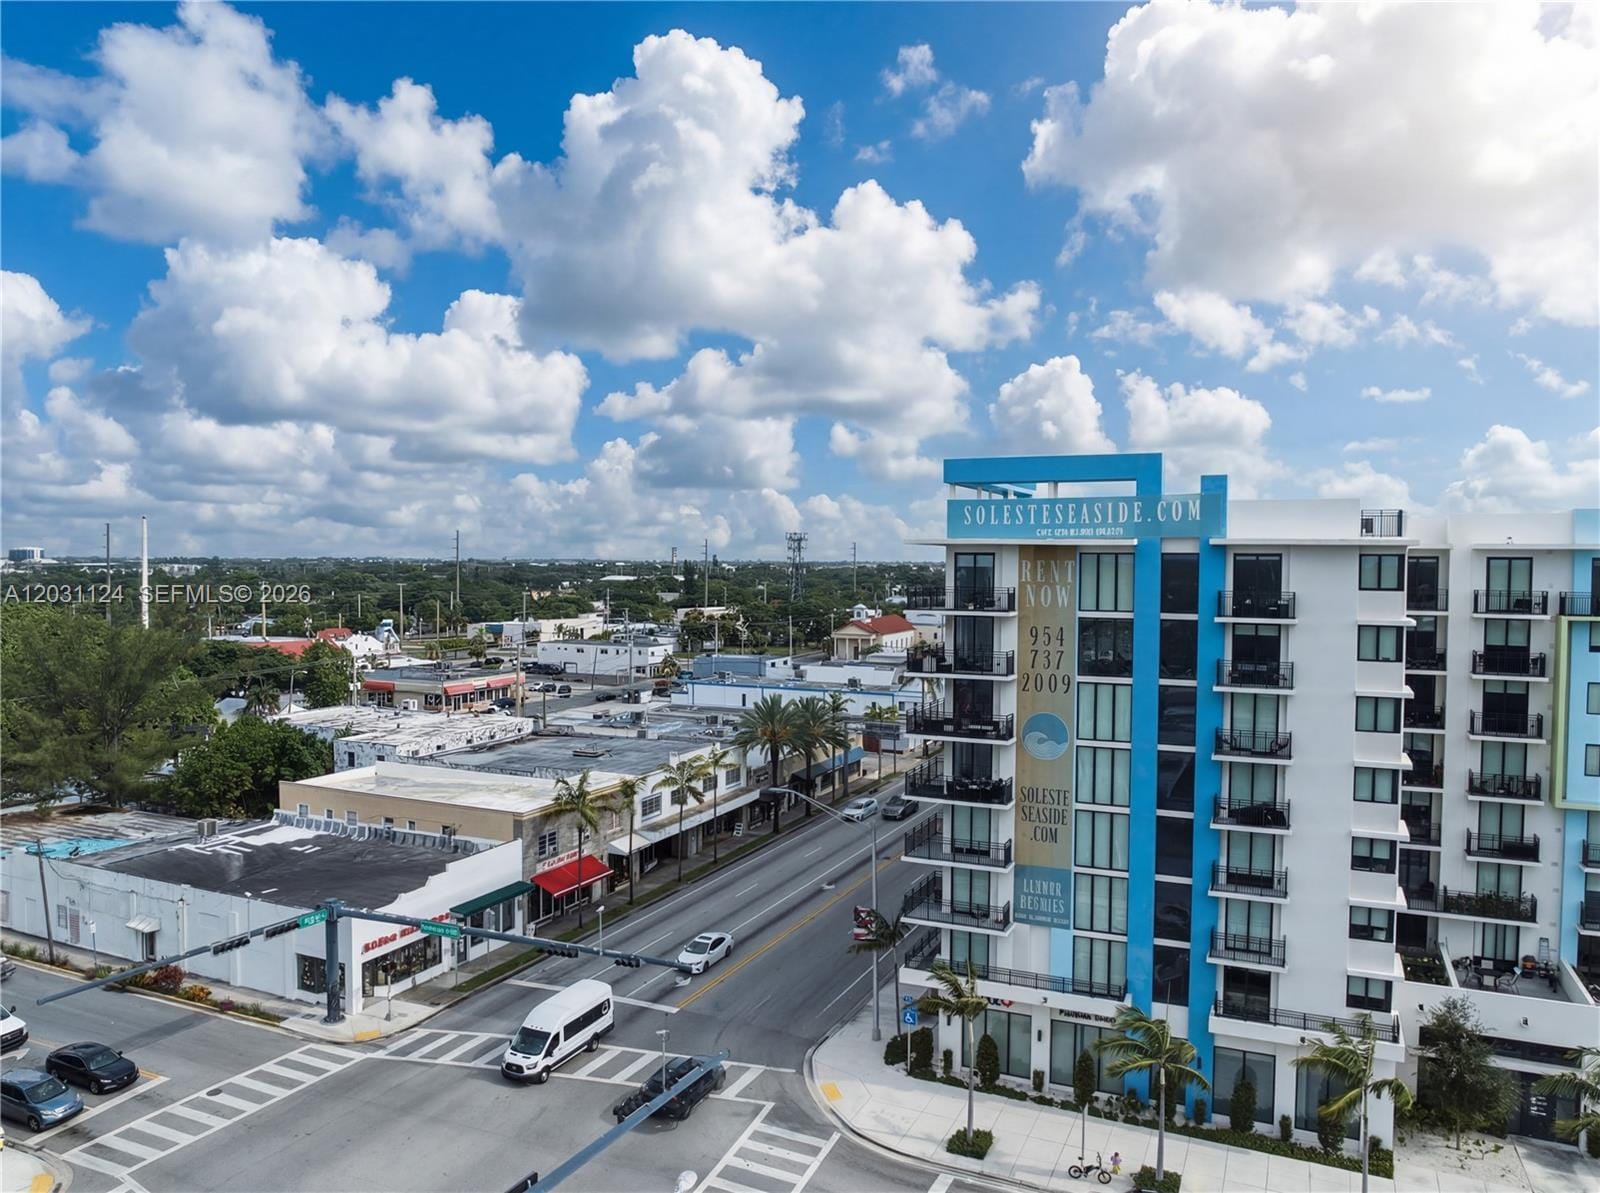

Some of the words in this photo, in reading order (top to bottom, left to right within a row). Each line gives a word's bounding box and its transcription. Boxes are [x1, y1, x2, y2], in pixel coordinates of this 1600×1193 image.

[963, 499, 1202, 526] SOLESTESEASIDE.COM
[1021, 559, 1076, 583] RENT
[1025, 584, 1071, 609] NOW
[1029, 625, 1066, 648] 954
[1029, 648, 1065, 671] 737
[1021, 672, 1072, 695] 2009
[1019, 785, 1070, 808] SOLESTE
[1020, 805, 1068, 826] SEASIDE
[1030, 825, 1059, 844] .COM
